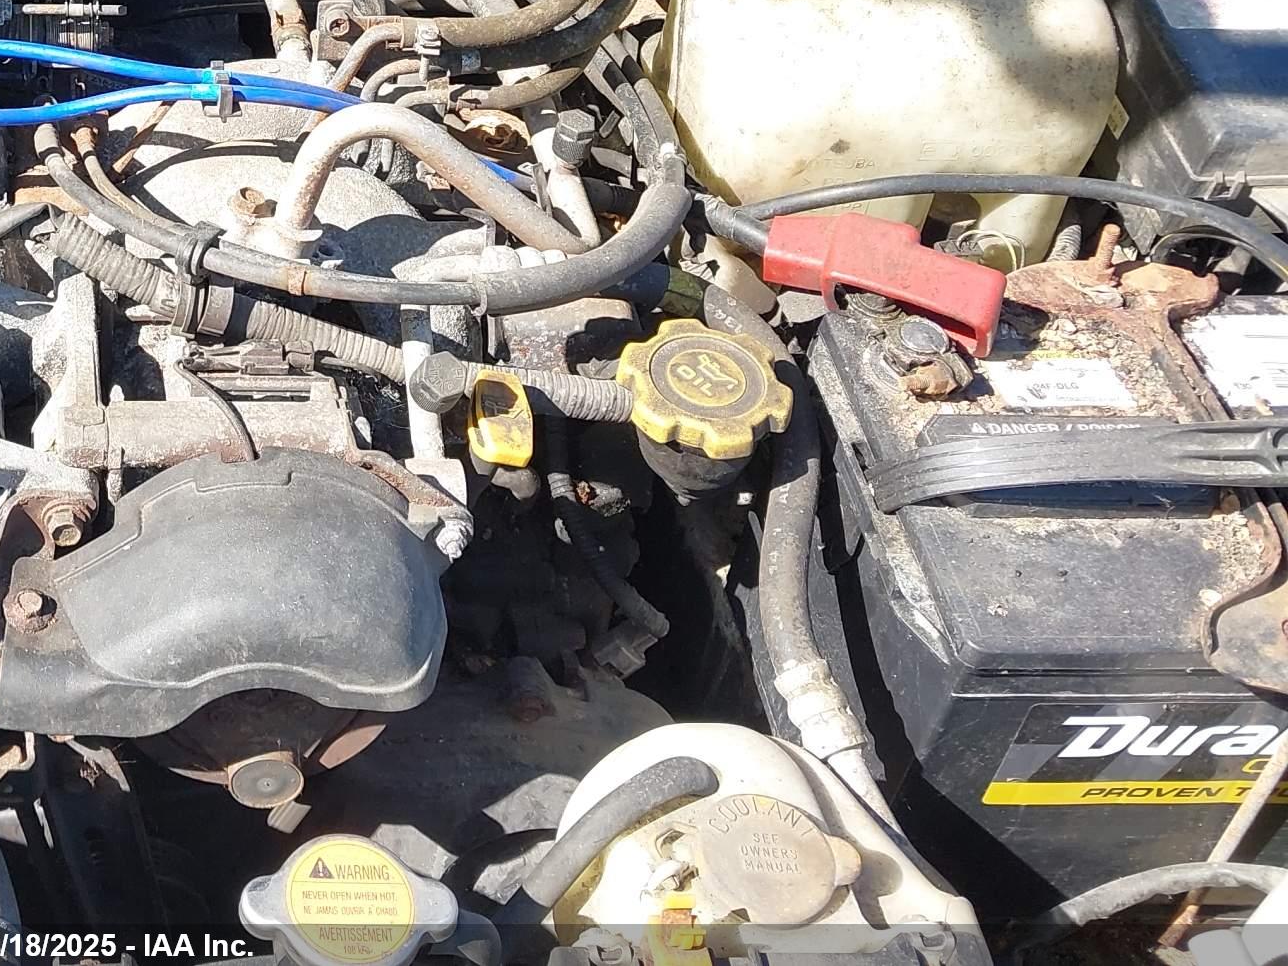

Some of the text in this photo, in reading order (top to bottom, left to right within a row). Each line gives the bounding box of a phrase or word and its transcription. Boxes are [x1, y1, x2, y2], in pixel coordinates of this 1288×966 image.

[677, 364, 713, 397] OIL
[991, 422, 1060, 435] DANGER
[1080, 786, 1223, 799] PROVEN
[708, 796, 819, 836] COOLANT
[753, 833, 780, 845] SEE
[740, 844, 799, 860] OWNERS
[335, 864, 390, 881] WARNING
[743, 859, 802, 875] MANUAL
[302, 890, 398, 902] NEVER OPEN WHEN HOT.
